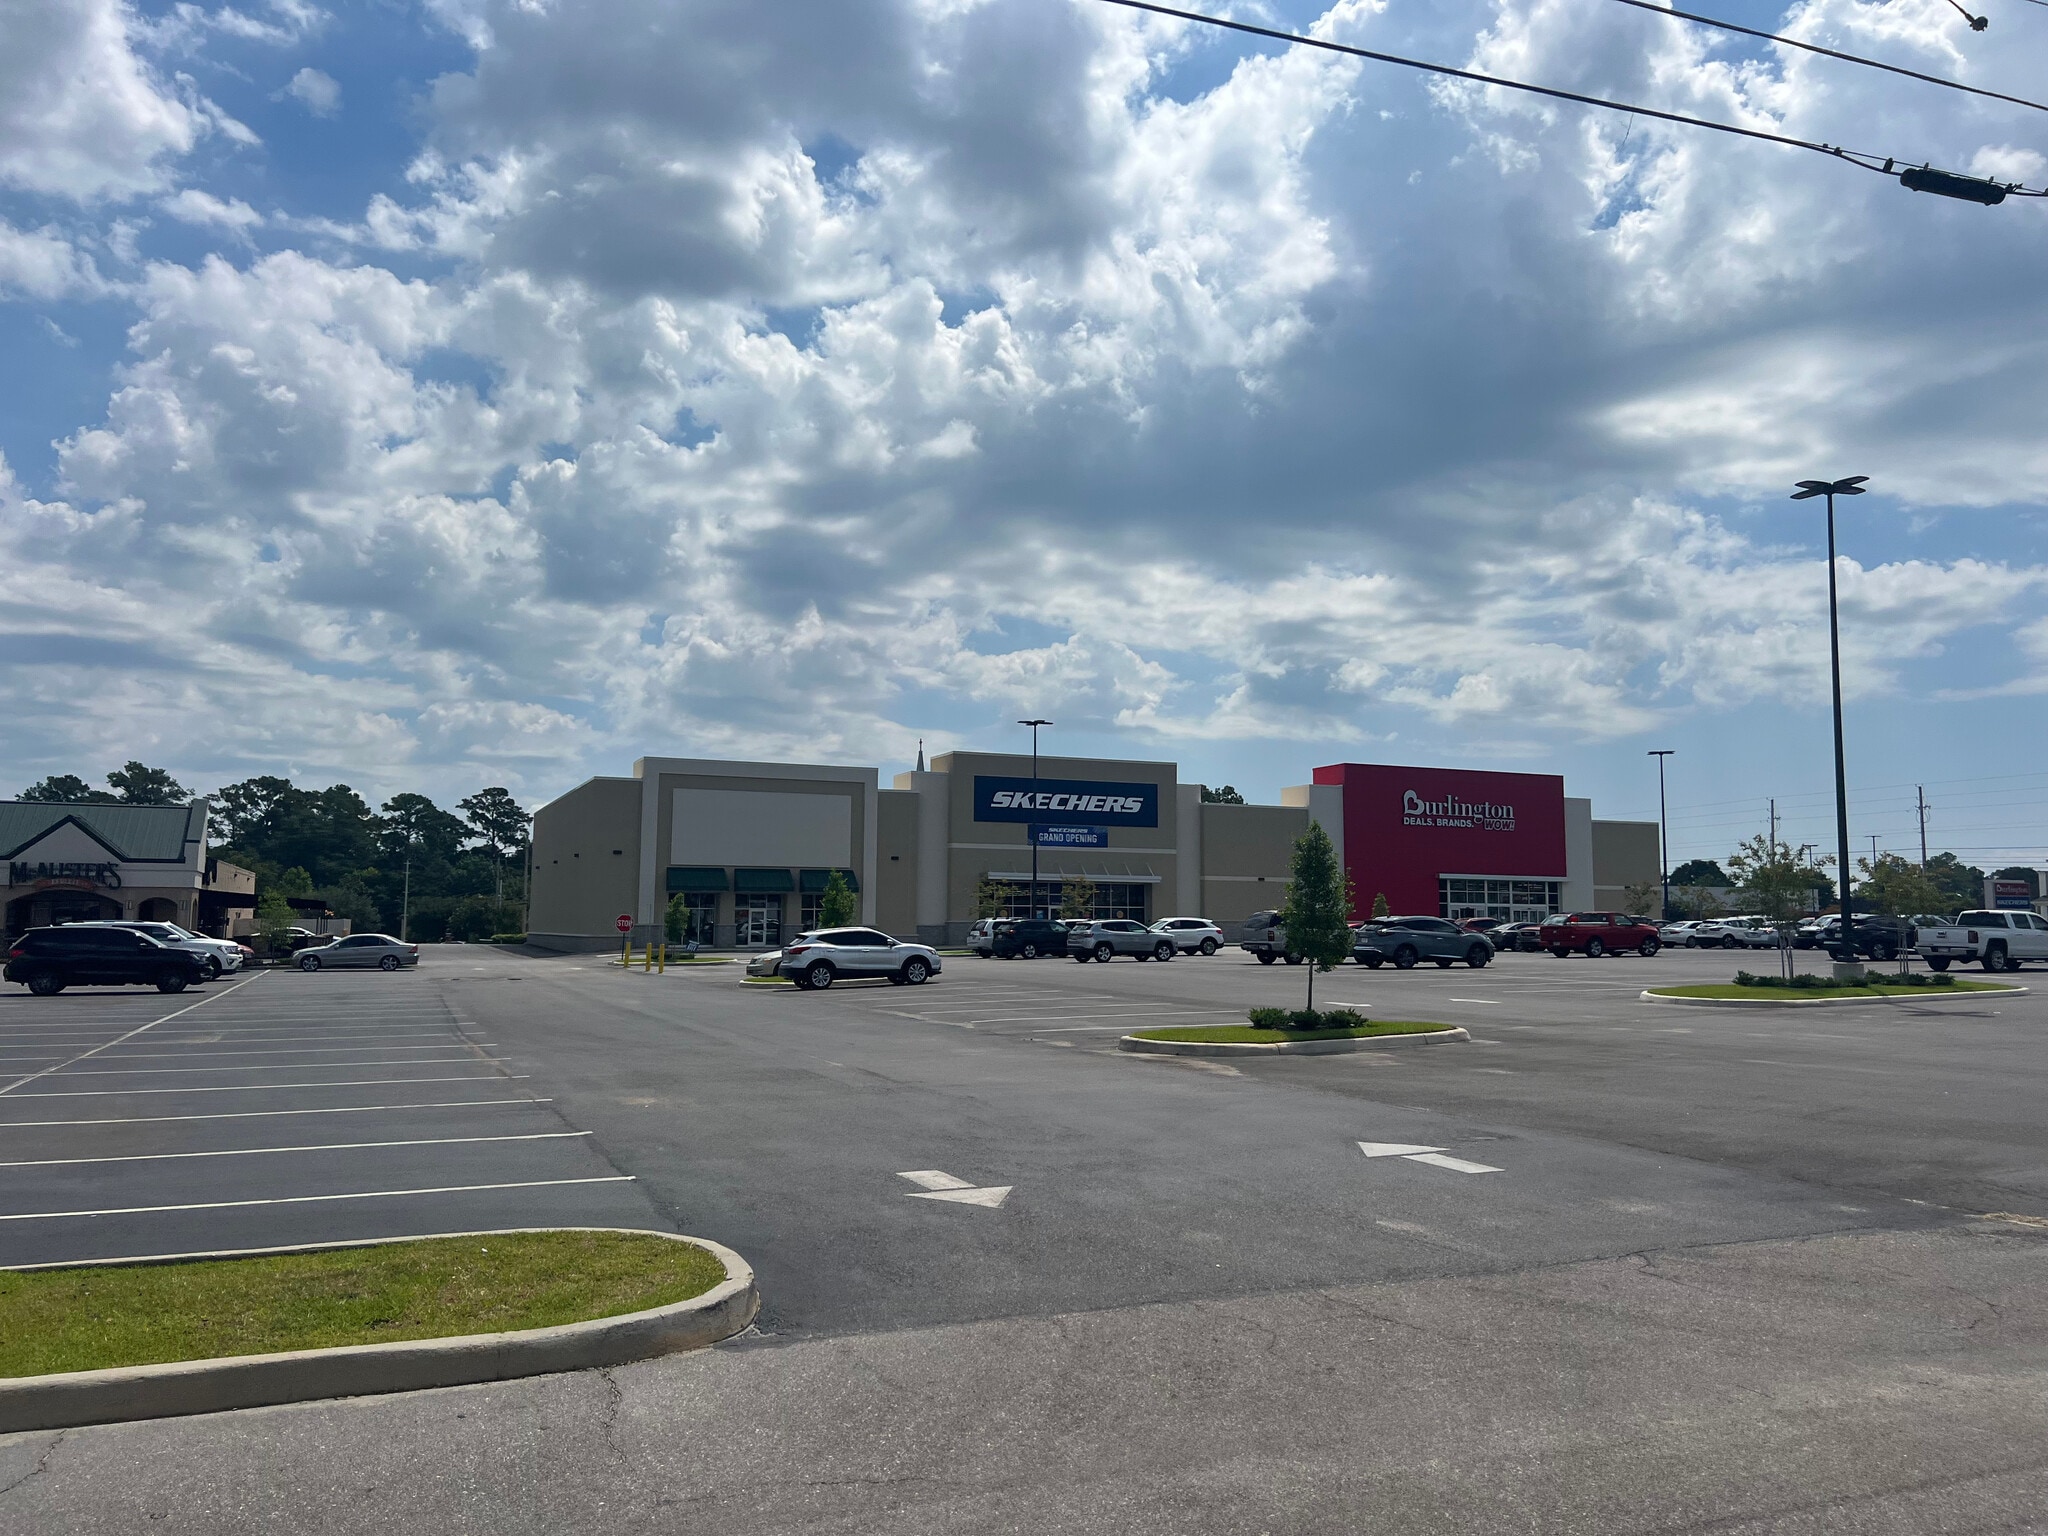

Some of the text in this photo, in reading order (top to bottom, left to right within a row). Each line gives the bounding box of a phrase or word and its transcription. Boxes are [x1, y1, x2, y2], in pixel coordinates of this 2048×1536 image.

[991, 791, 1143, 813] SKECHERS
[1403, 789, 1515, 824] Burlington
[1403, 817, 1515, 831] DEALS. BRANDS. WOW!
[1038, 832, 1098, 843] GRAND OPENING
